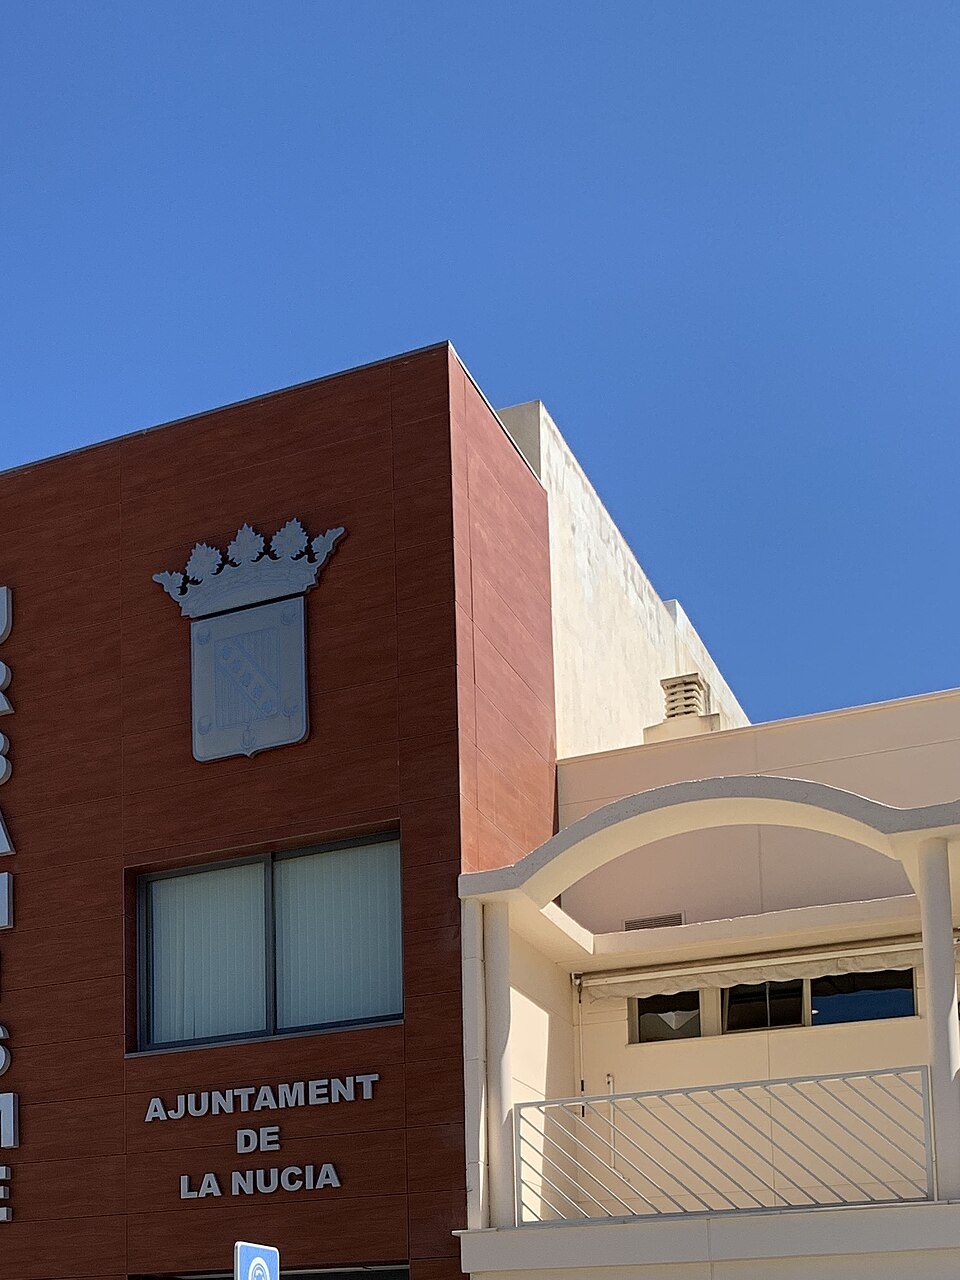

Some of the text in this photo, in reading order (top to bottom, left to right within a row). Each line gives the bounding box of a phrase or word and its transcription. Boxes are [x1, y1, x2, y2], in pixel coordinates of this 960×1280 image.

[144, 1073, 380, 1122] AJUNTAMENT
[236, 1126, 281, 1154] DE
[180, 1163, 341, 1199] LA NUCIA
